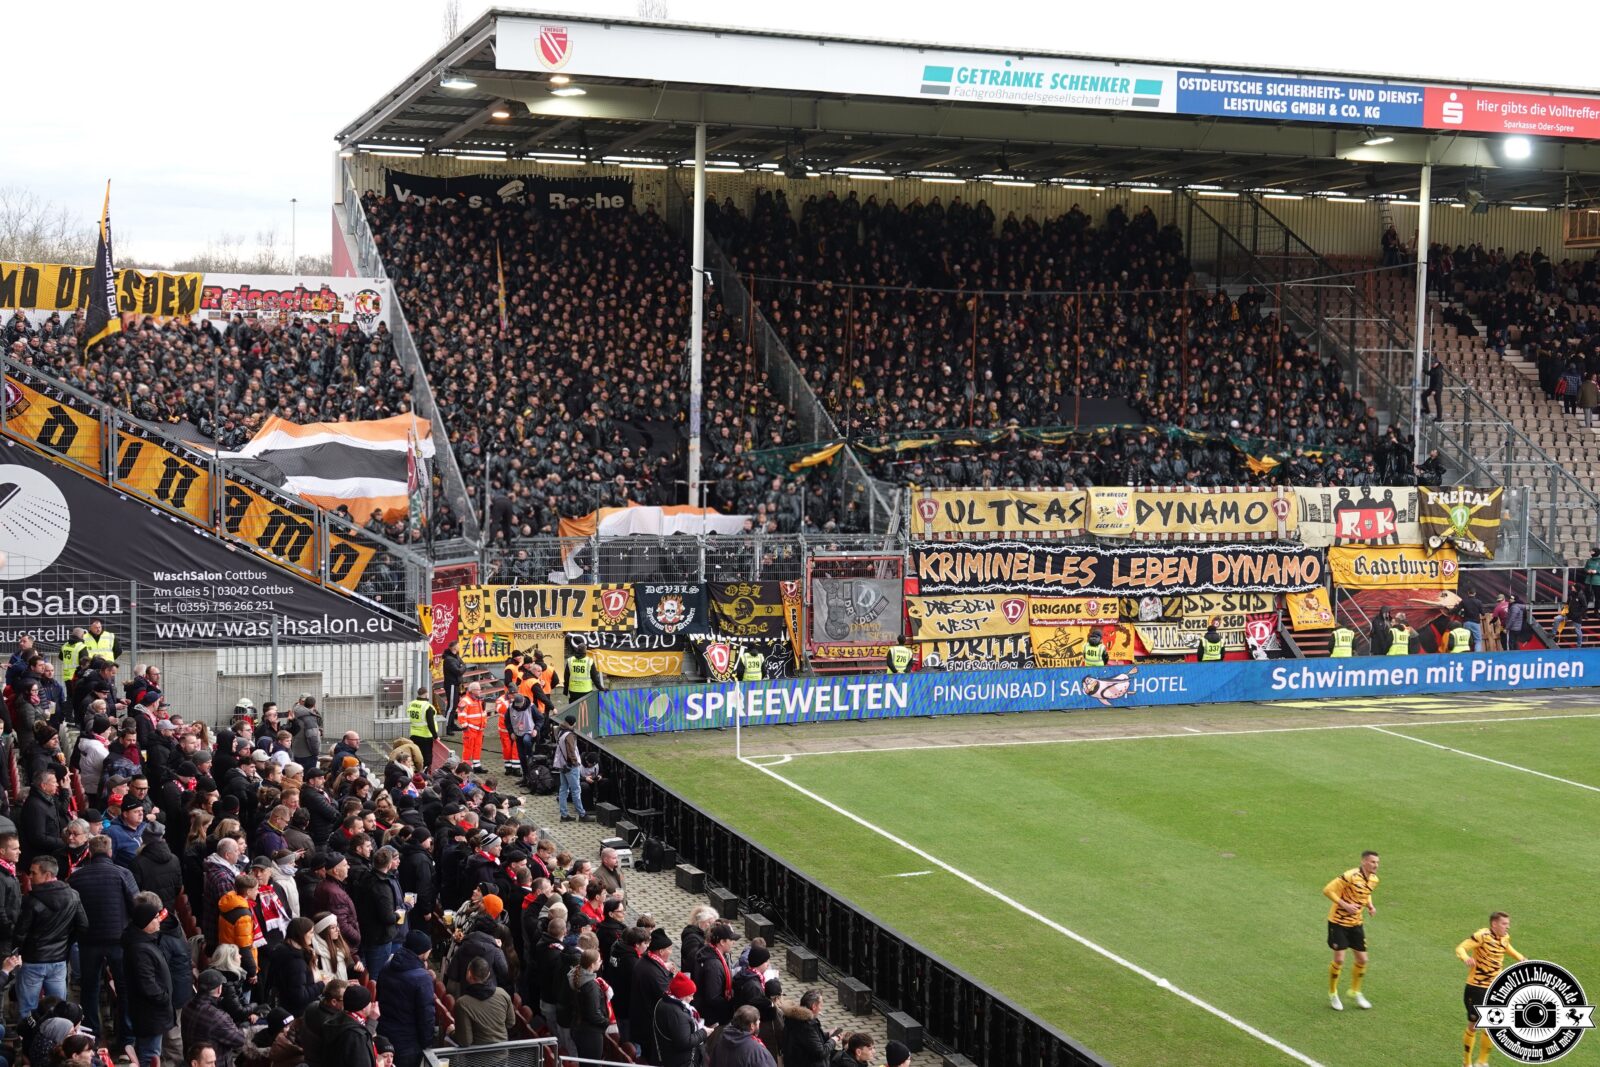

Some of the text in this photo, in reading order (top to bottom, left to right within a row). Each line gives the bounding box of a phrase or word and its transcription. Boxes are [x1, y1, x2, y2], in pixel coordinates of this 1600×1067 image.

[1050, 72, 1131, 94] SCHENKER
[1179, 77, 1423, 105] OSTDEUTSCHE SICHERHEITS- UND DIENST-
[953, 86, 1129, 106] Fachgroßhandelsgesellschaft mbH
[1223, 97, 1380, 118] LEISTUNGS GMBH & CO. KG
[1476, 99, 1600, 120] Hier gibts die Volltreffer
[1503, 120, 1575, 132] Sparkasse Oder-Spree
[55, 266, 198, 317] DRSDEN
[1427, 490, 1492, 507] FREITAL
[944, 497, 1269, 527] ULTRAS DYNAMO
[153, 570, 268, 582] WaschSalon Cottbus
[919, 551, 1321, 588] KRIMINELLES LEBEN DYNAMO
[153, 585, 295, 598] Am Gleis 5 03042 Cottbus
[645, 585, 700, 594] DEVILS
[153, 600, 275, 613] Tel. (0355) 756 266 251
[494, 585, 588, 619] GÖRLITZ
[923, 599, 996, 618] DRESDEN
[1032, 603, 1082, 615] BRIGADE
[1102, 602, 1118, 615] 53
[155, 613, 394, 639] www.waschsalon.eu
[936, 617, 989, 635] WEST
[1223, 615, 1245, 627] SGD
[572, 665, 585, 674] 166
[747, 660, 760, 669] 339
[1271, 657, 1584, 690] Schwimmen mit Pinguinen
[934, 680, 1047, 702] PINGUINBAD
[1133, 676, 1188, 693] HOTEL
[686, 681, 908, 721] SPREEWELTEN
